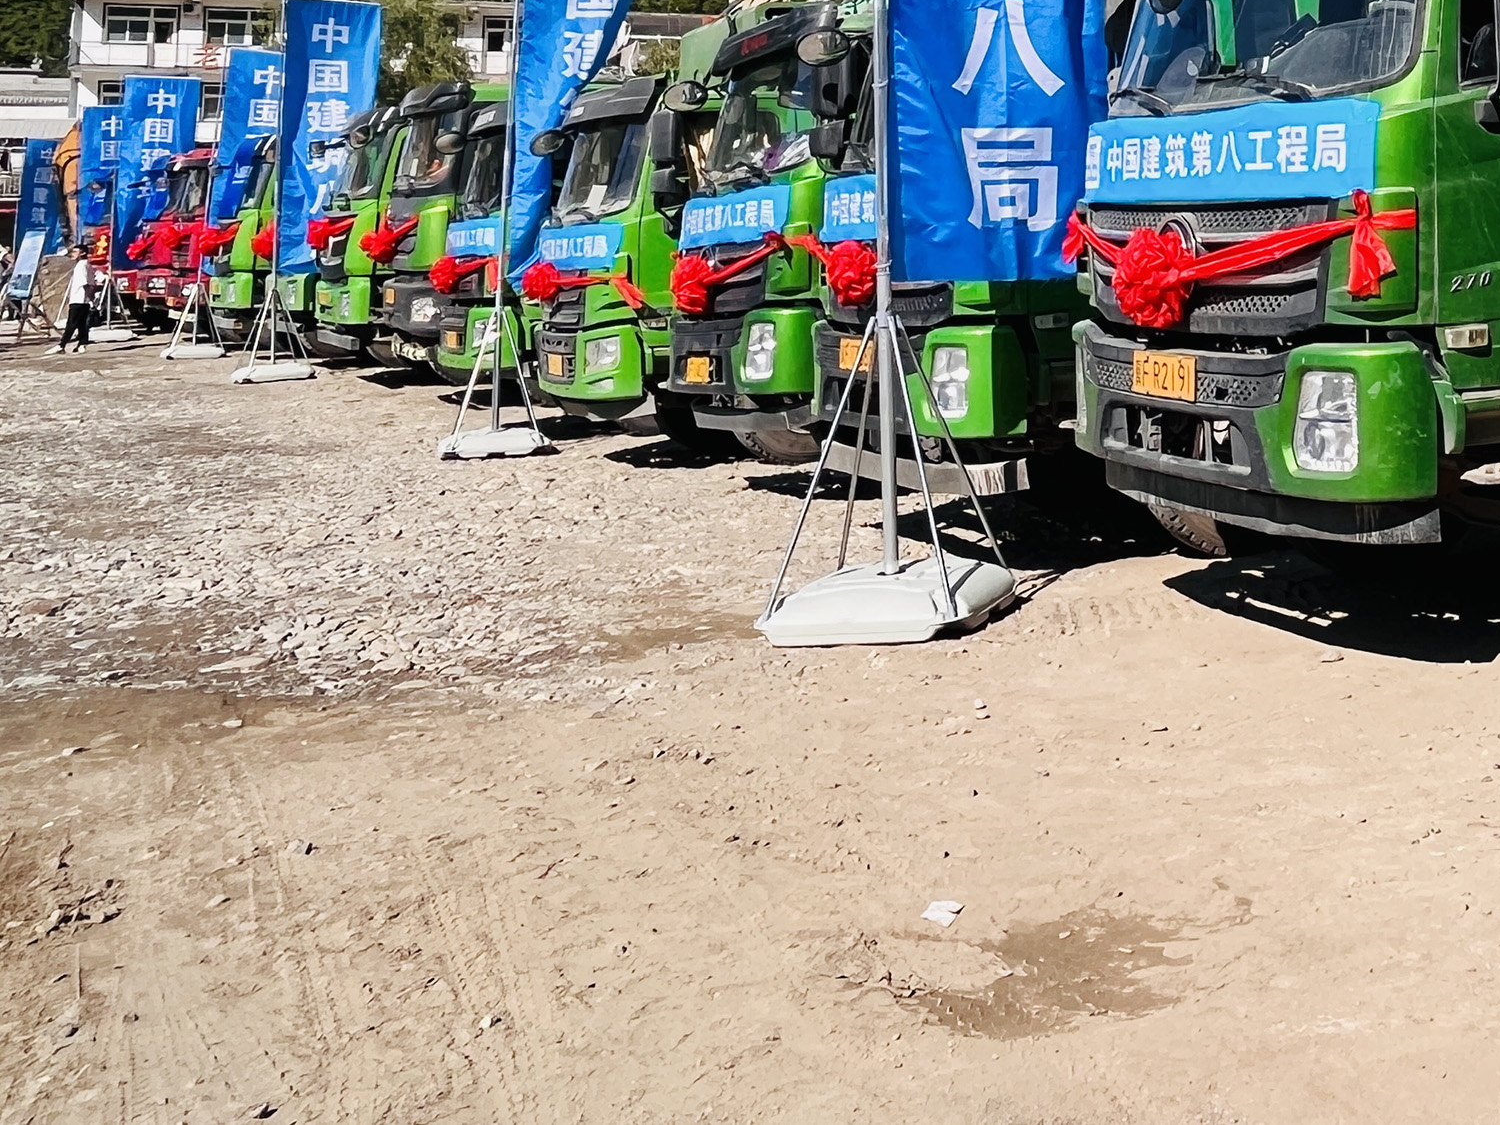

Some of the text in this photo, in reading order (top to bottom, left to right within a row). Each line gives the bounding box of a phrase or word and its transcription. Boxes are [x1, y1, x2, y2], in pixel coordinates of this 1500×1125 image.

[1106, 123, 1347, 183] 中国建筑第八工程局
